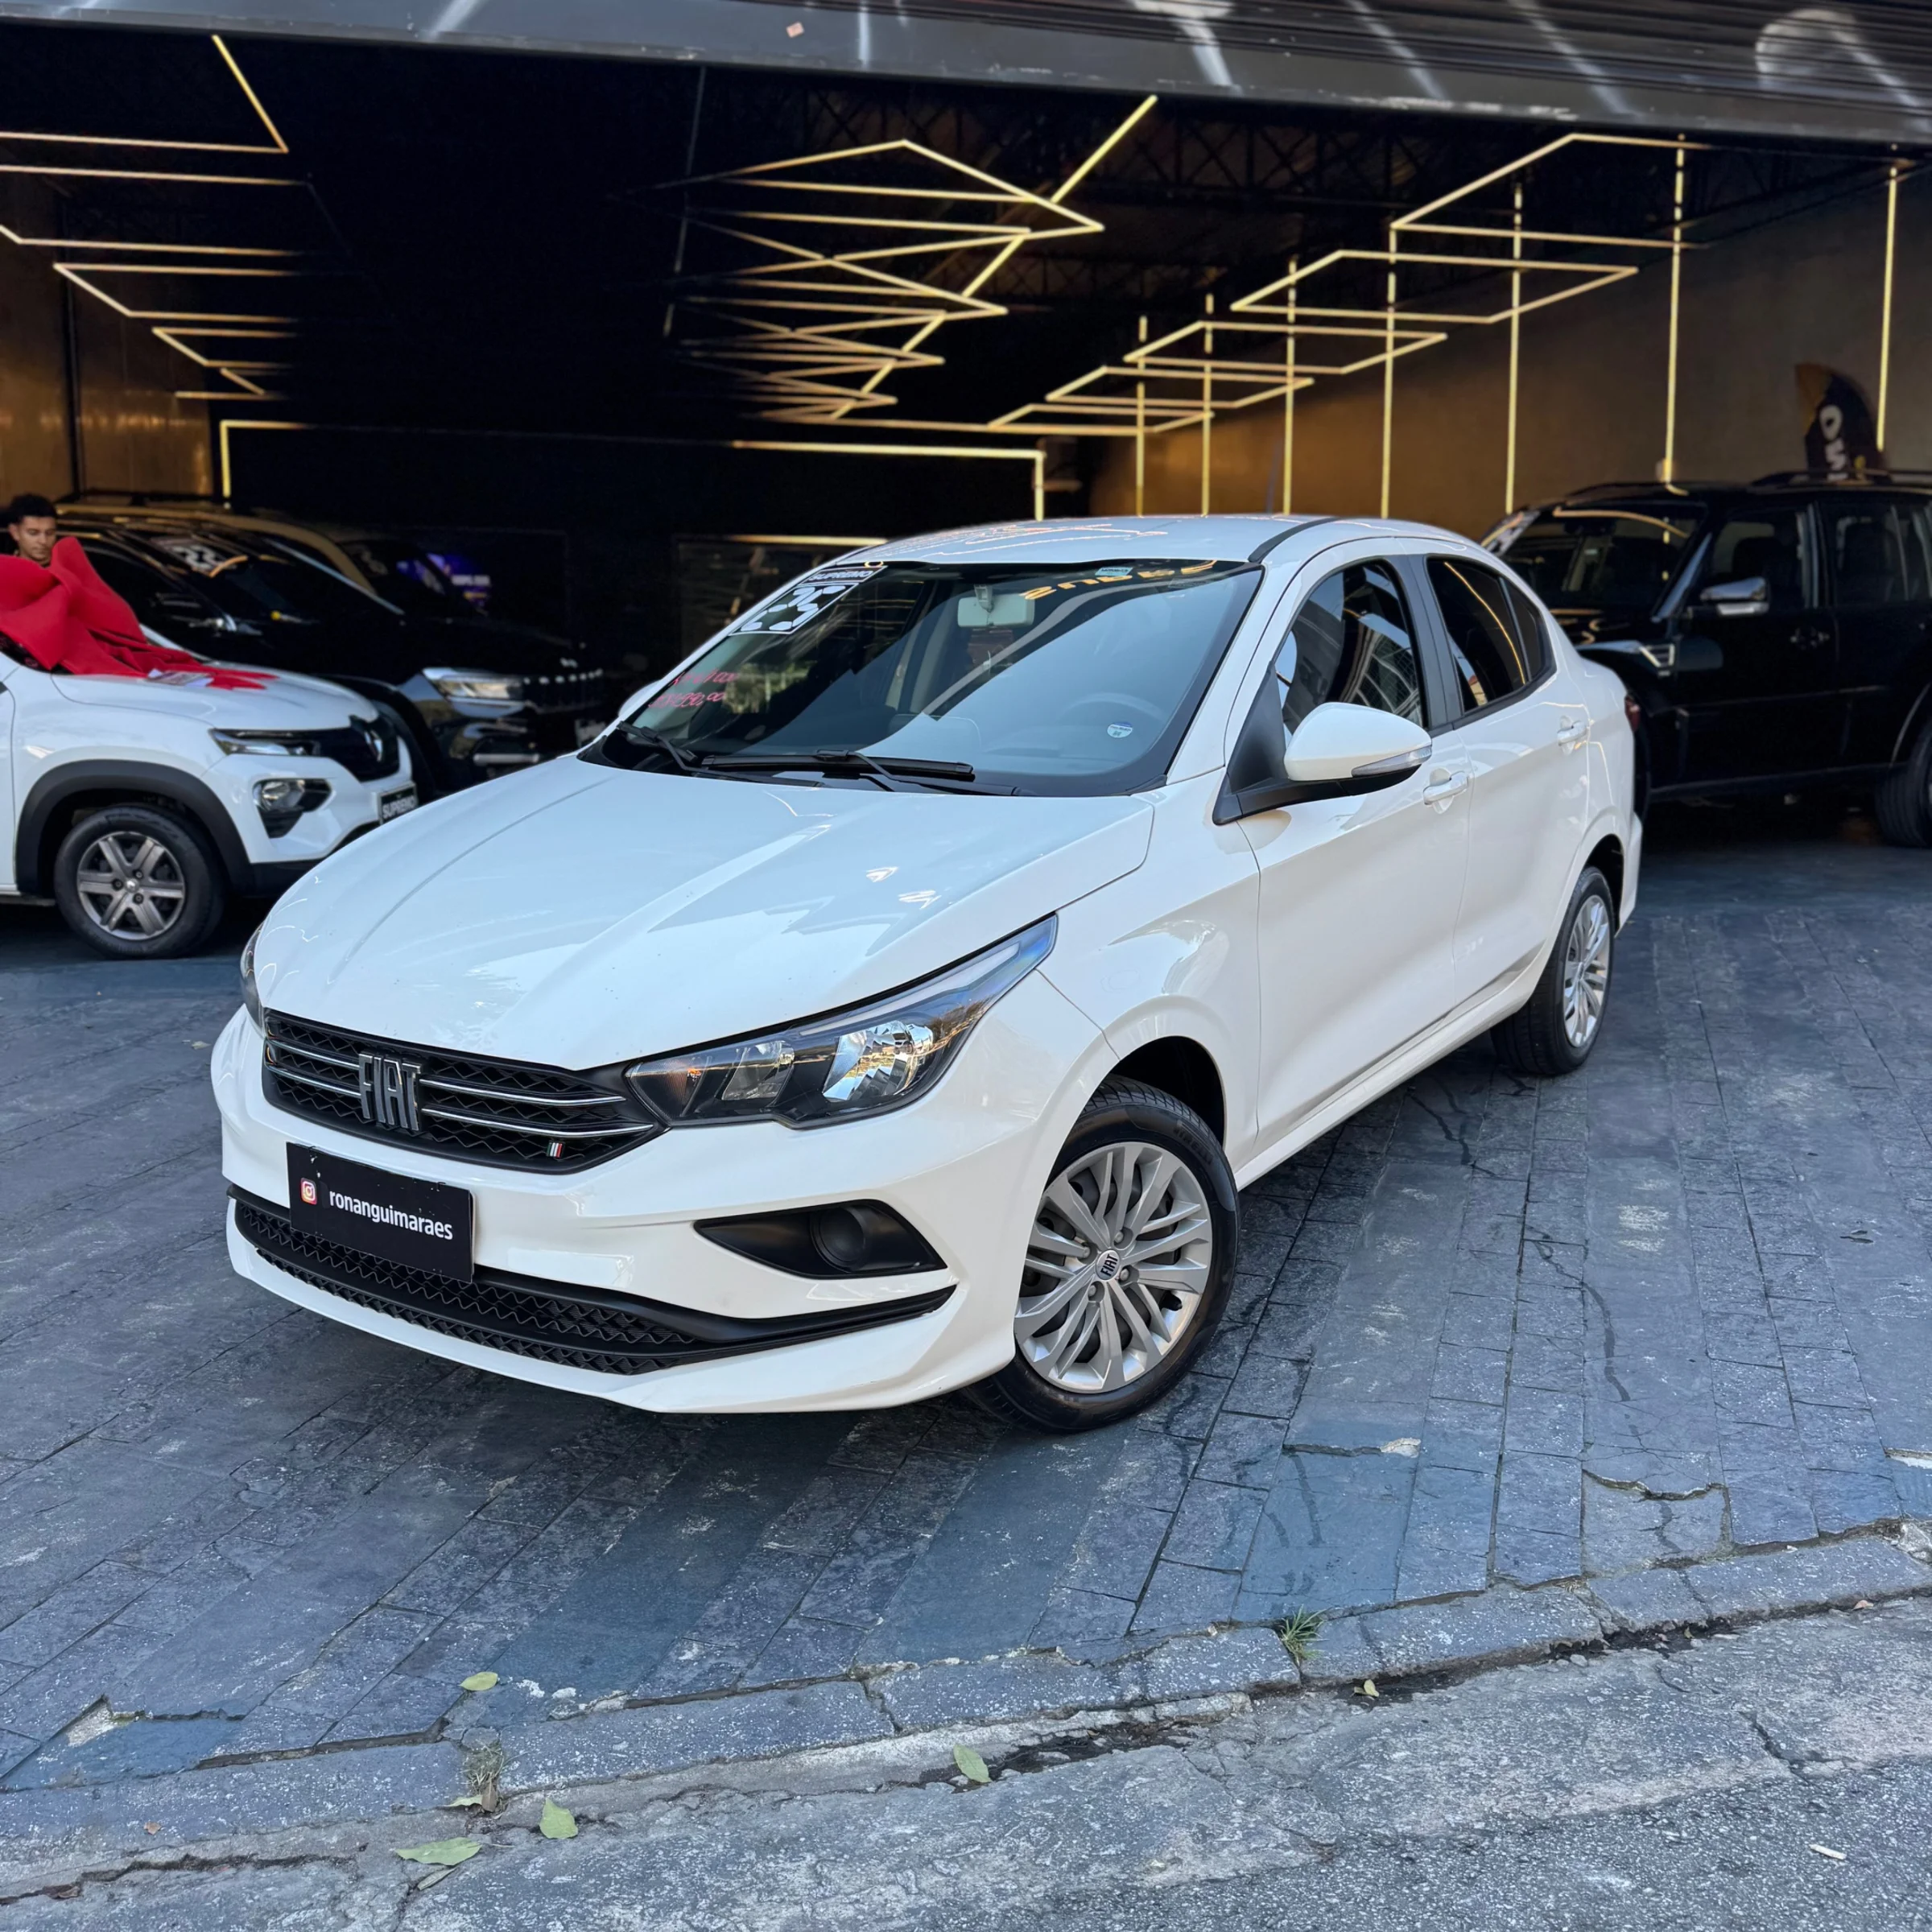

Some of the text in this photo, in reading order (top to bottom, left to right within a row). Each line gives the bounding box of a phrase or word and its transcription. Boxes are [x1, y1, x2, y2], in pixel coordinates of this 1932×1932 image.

[740, 585, 845, 631] 25
[358, 1053, 421, 1131] FIAT
[329, 1191, 453, 1241] ronanguimaraes
[1100, 1253, 1119, 1277] FIAT
